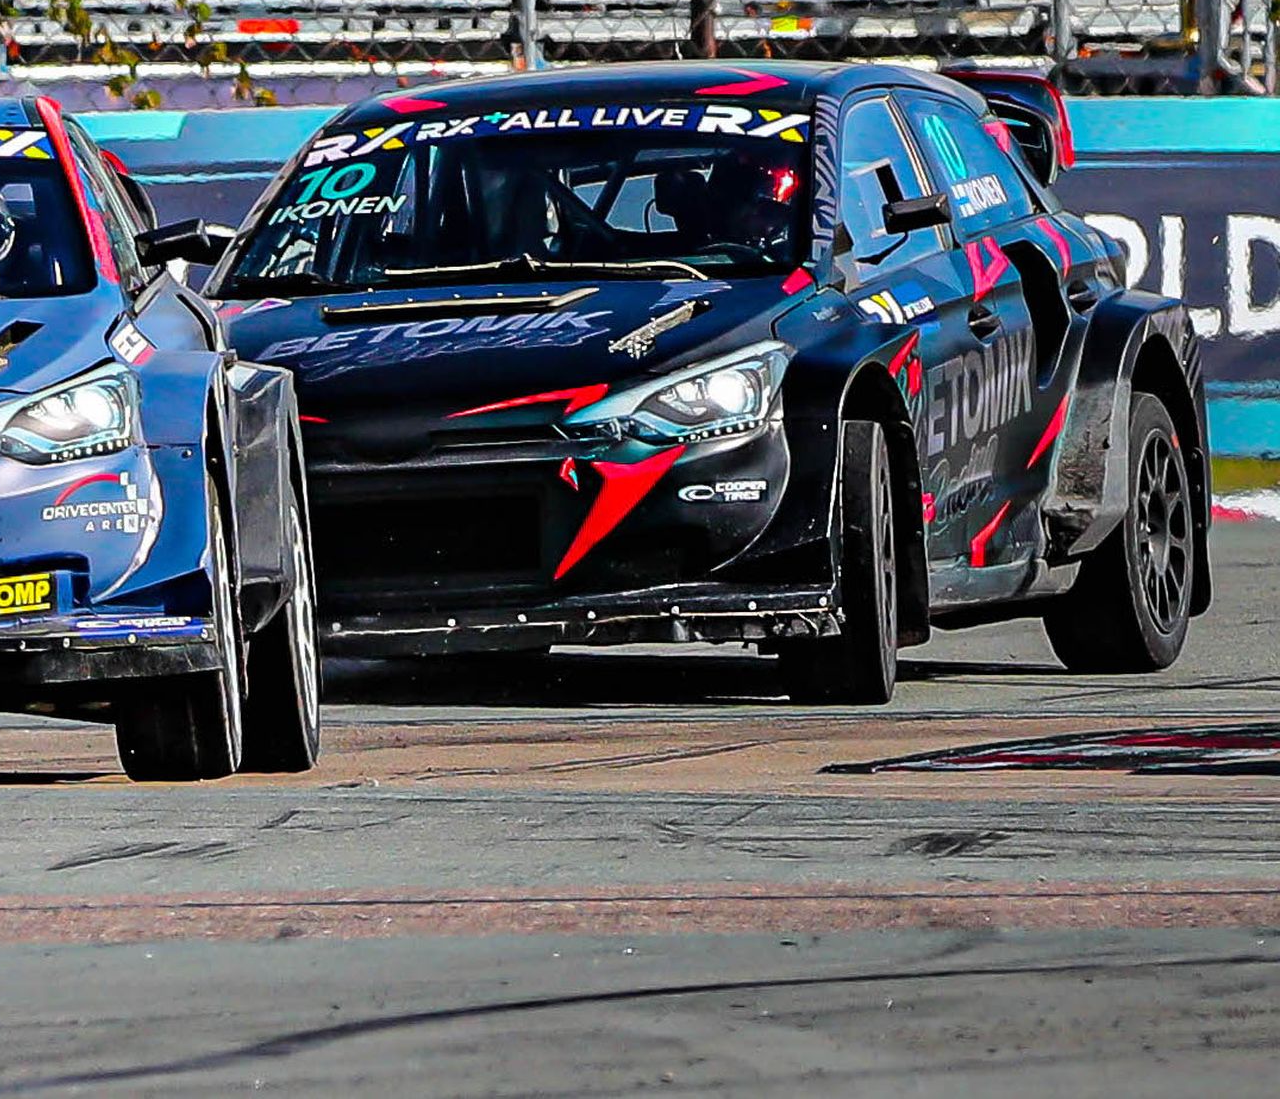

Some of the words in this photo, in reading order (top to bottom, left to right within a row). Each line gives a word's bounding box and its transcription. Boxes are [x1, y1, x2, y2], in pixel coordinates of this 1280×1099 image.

[500, 108, 579, 131] ALL
[590, 107, 689, 128] LIVE
[696, 105, 810, 142] RX
[303, 121, 413, 168] RX
[297, 161, 377, 205] 10
[268, 194, 407, 227] IKONEN
[255, 310, 613, 361] BETOMIK
[42, 501, 137, 521] DRIVECENTER
